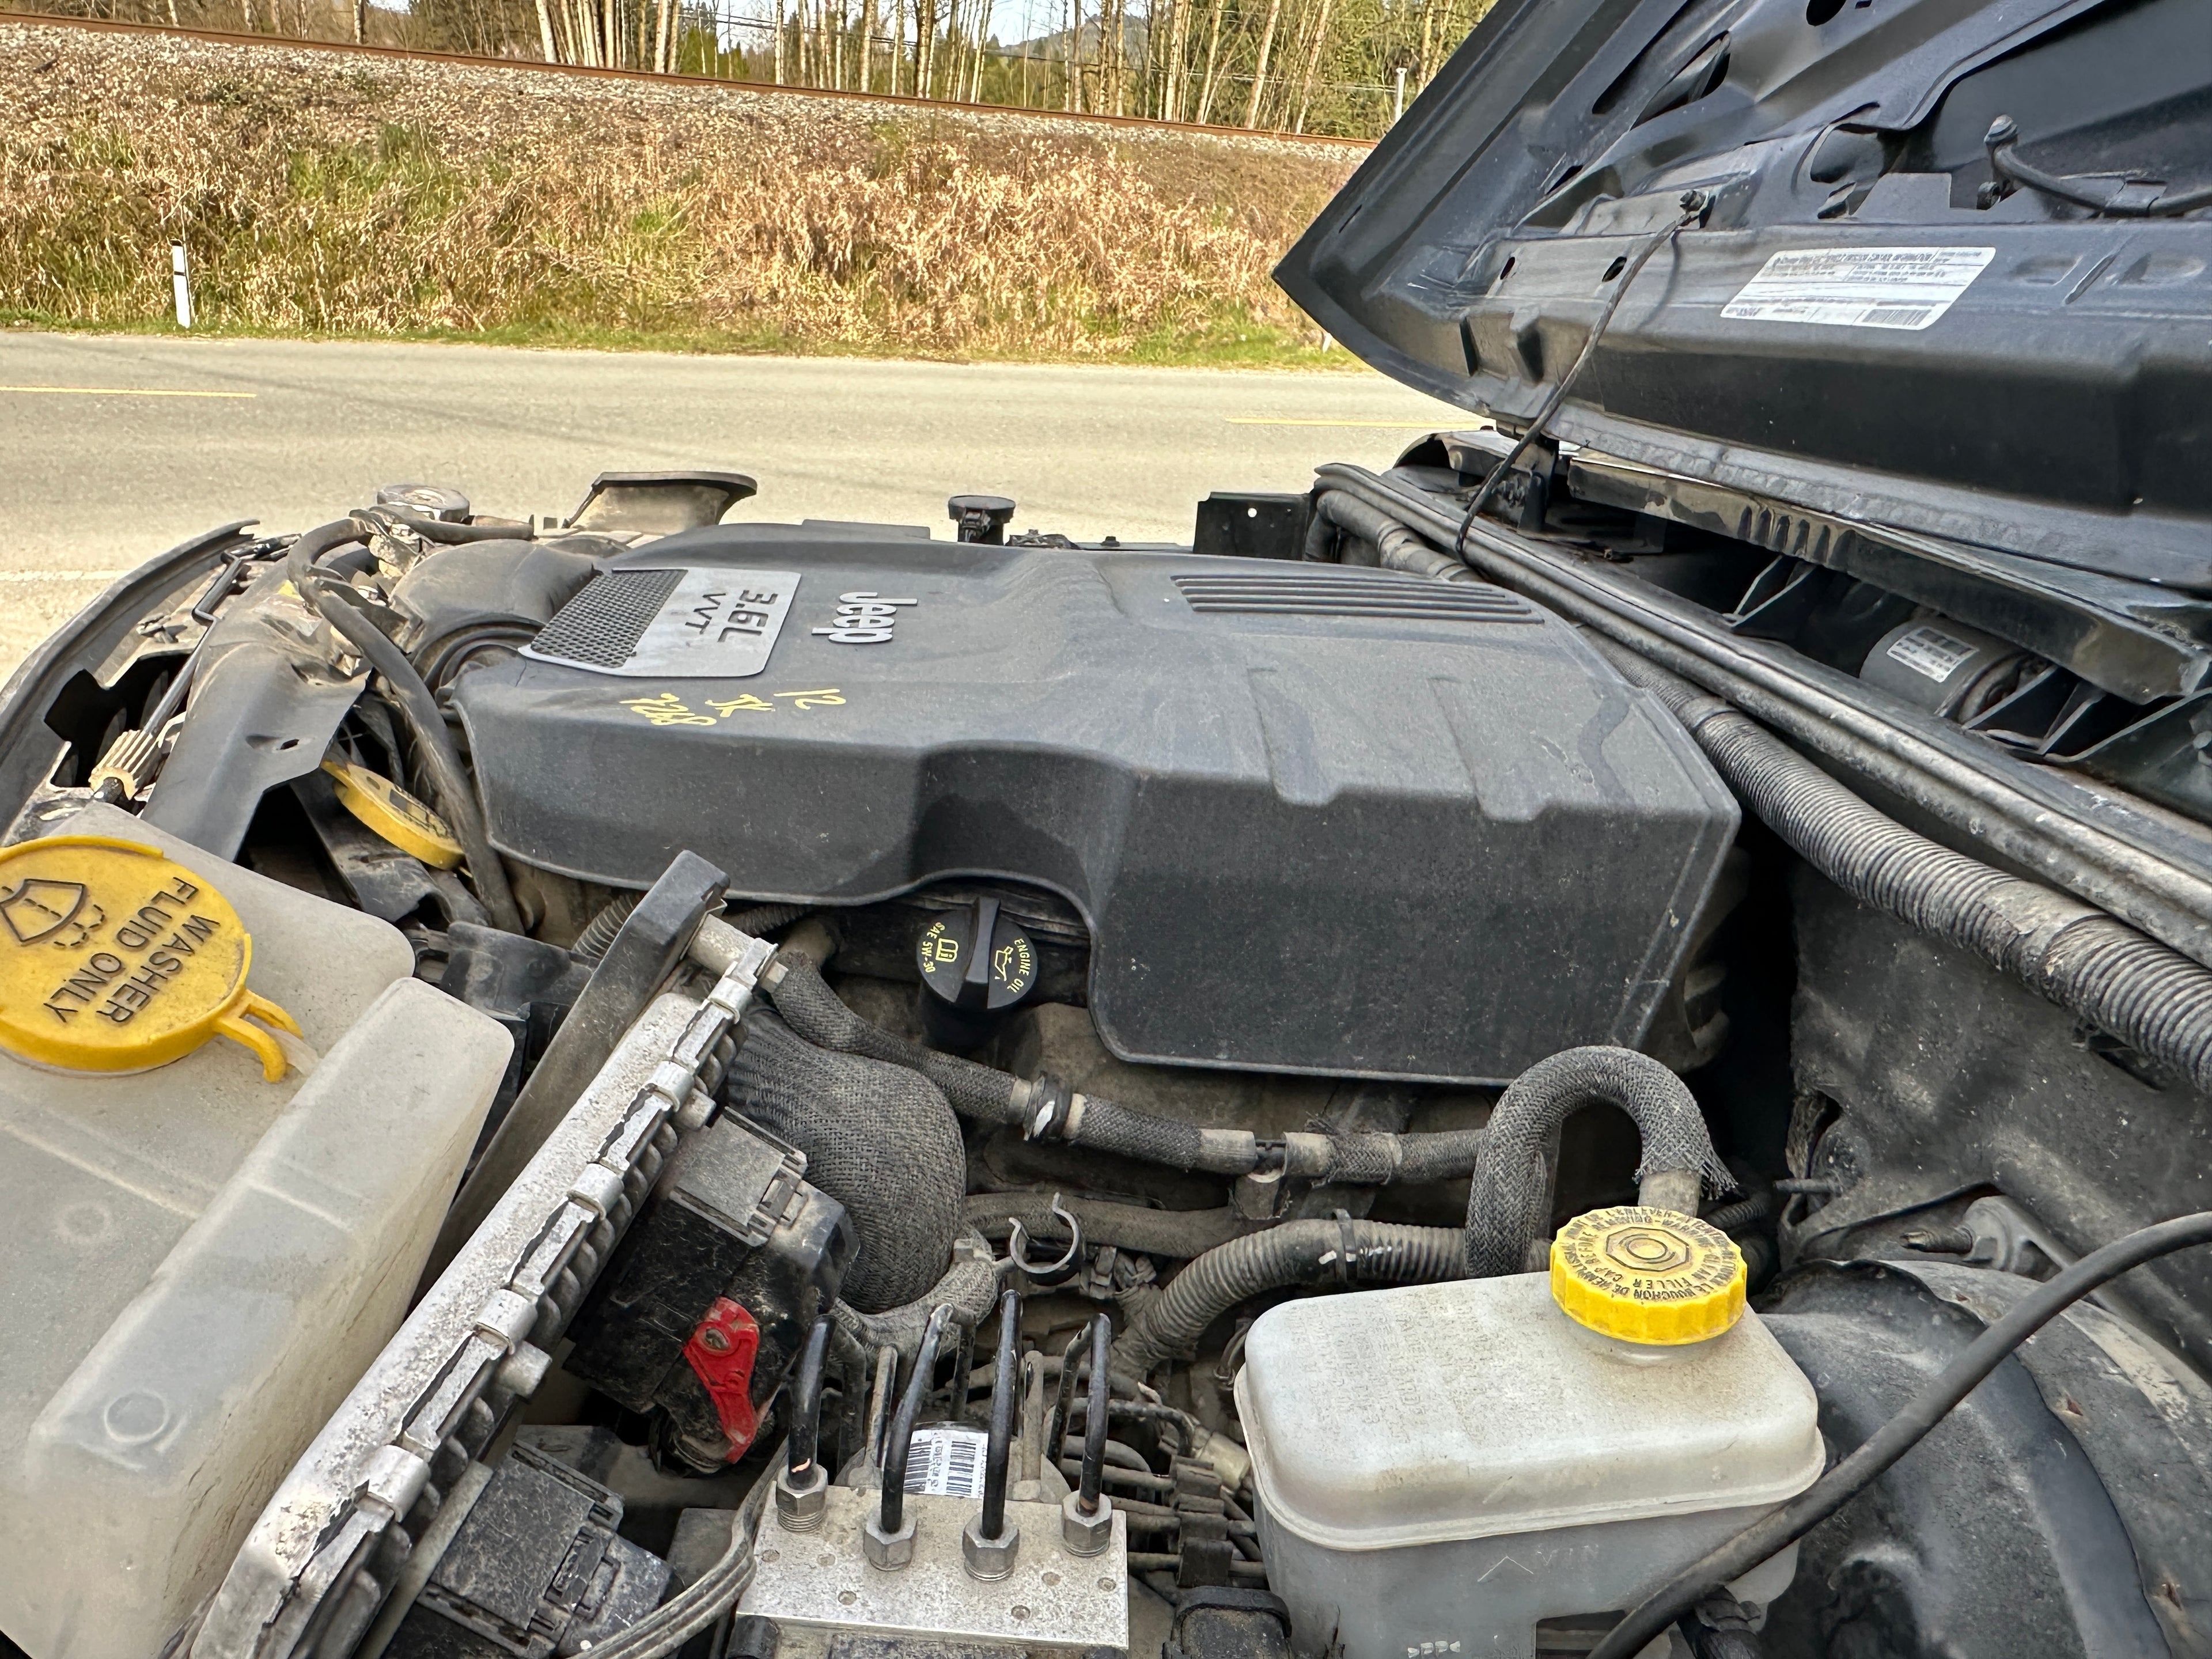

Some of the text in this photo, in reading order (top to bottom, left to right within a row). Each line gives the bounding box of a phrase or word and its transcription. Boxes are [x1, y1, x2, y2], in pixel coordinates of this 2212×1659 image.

[685, 592, 728, 634] VVT
[717, 589, 778, 643] 3.6L
[811, 592, 918, 643] Jeep
[773, 688, 847, 711] 12
[43, 877, 199, 1024] FLUID ONLY
[926, 922, 946, 939] SAE
[96, 914, 221, 1024] WASHER
[1006, 938, 1032, 994] ENGINE OIL
[1594, 1267, 1624, 1282] CAP
[1633, 1277, 1692, 1289] FILLER
